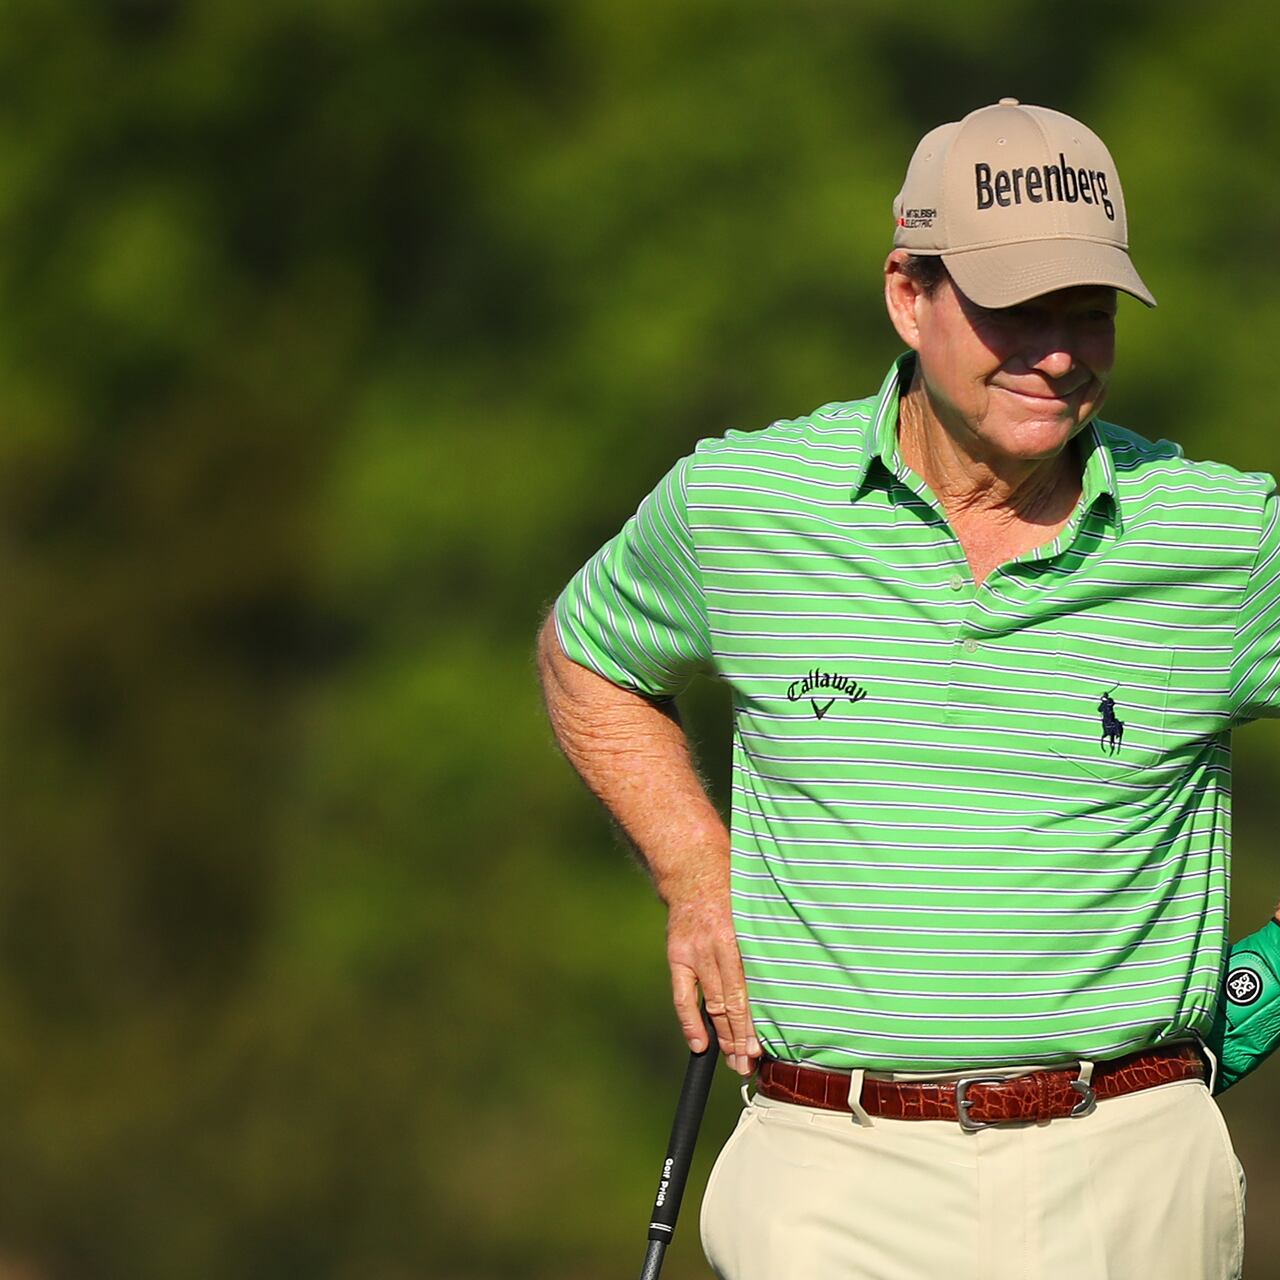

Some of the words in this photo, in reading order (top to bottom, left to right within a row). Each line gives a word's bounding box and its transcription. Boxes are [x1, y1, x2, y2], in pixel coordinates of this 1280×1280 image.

[975, 153, 1115, 222] Berenberg
[787, 667, 868, 704] Callaway
[662, 1158, 674, 1179] Golf
[656, 1180, 669, 1207] Pride
